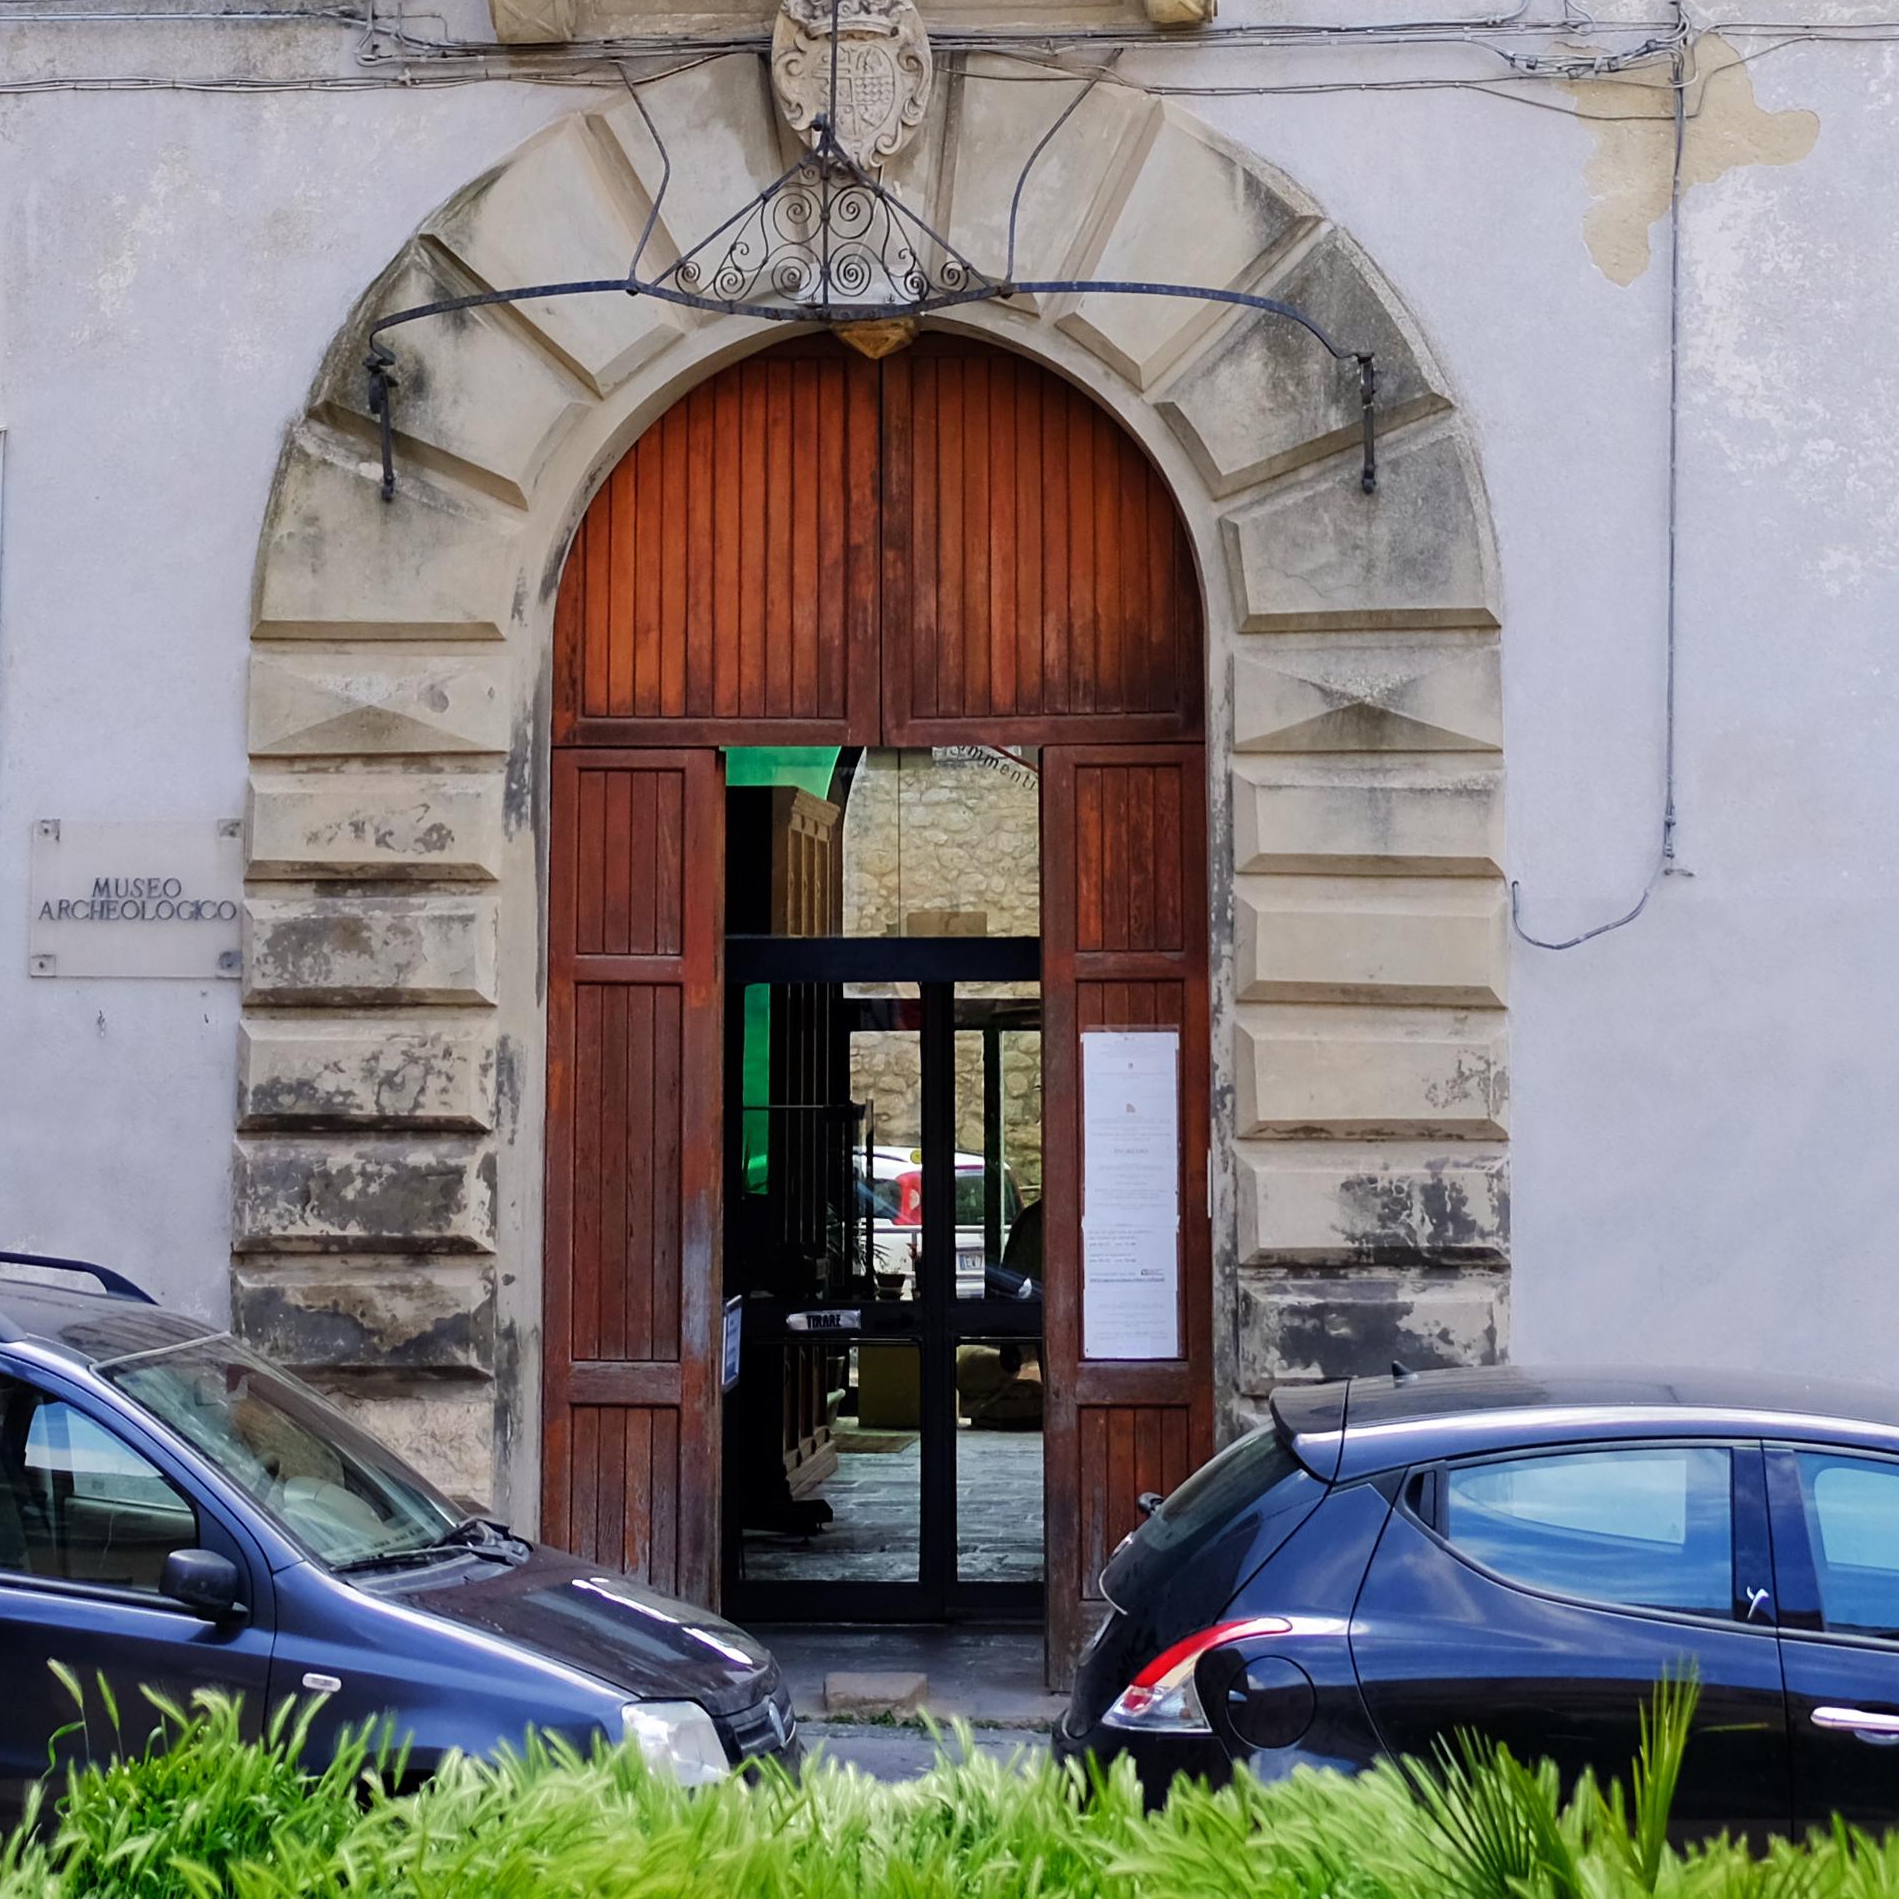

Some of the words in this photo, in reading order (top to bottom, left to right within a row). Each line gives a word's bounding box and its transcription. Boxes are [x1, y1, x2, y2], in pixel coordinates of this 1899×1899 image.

[91, 877, 183, 899] MUSEO
[38, 899, 238, 922] ARCHEOLOGICO
[807, 1313, 842, 1329] TIRARE
